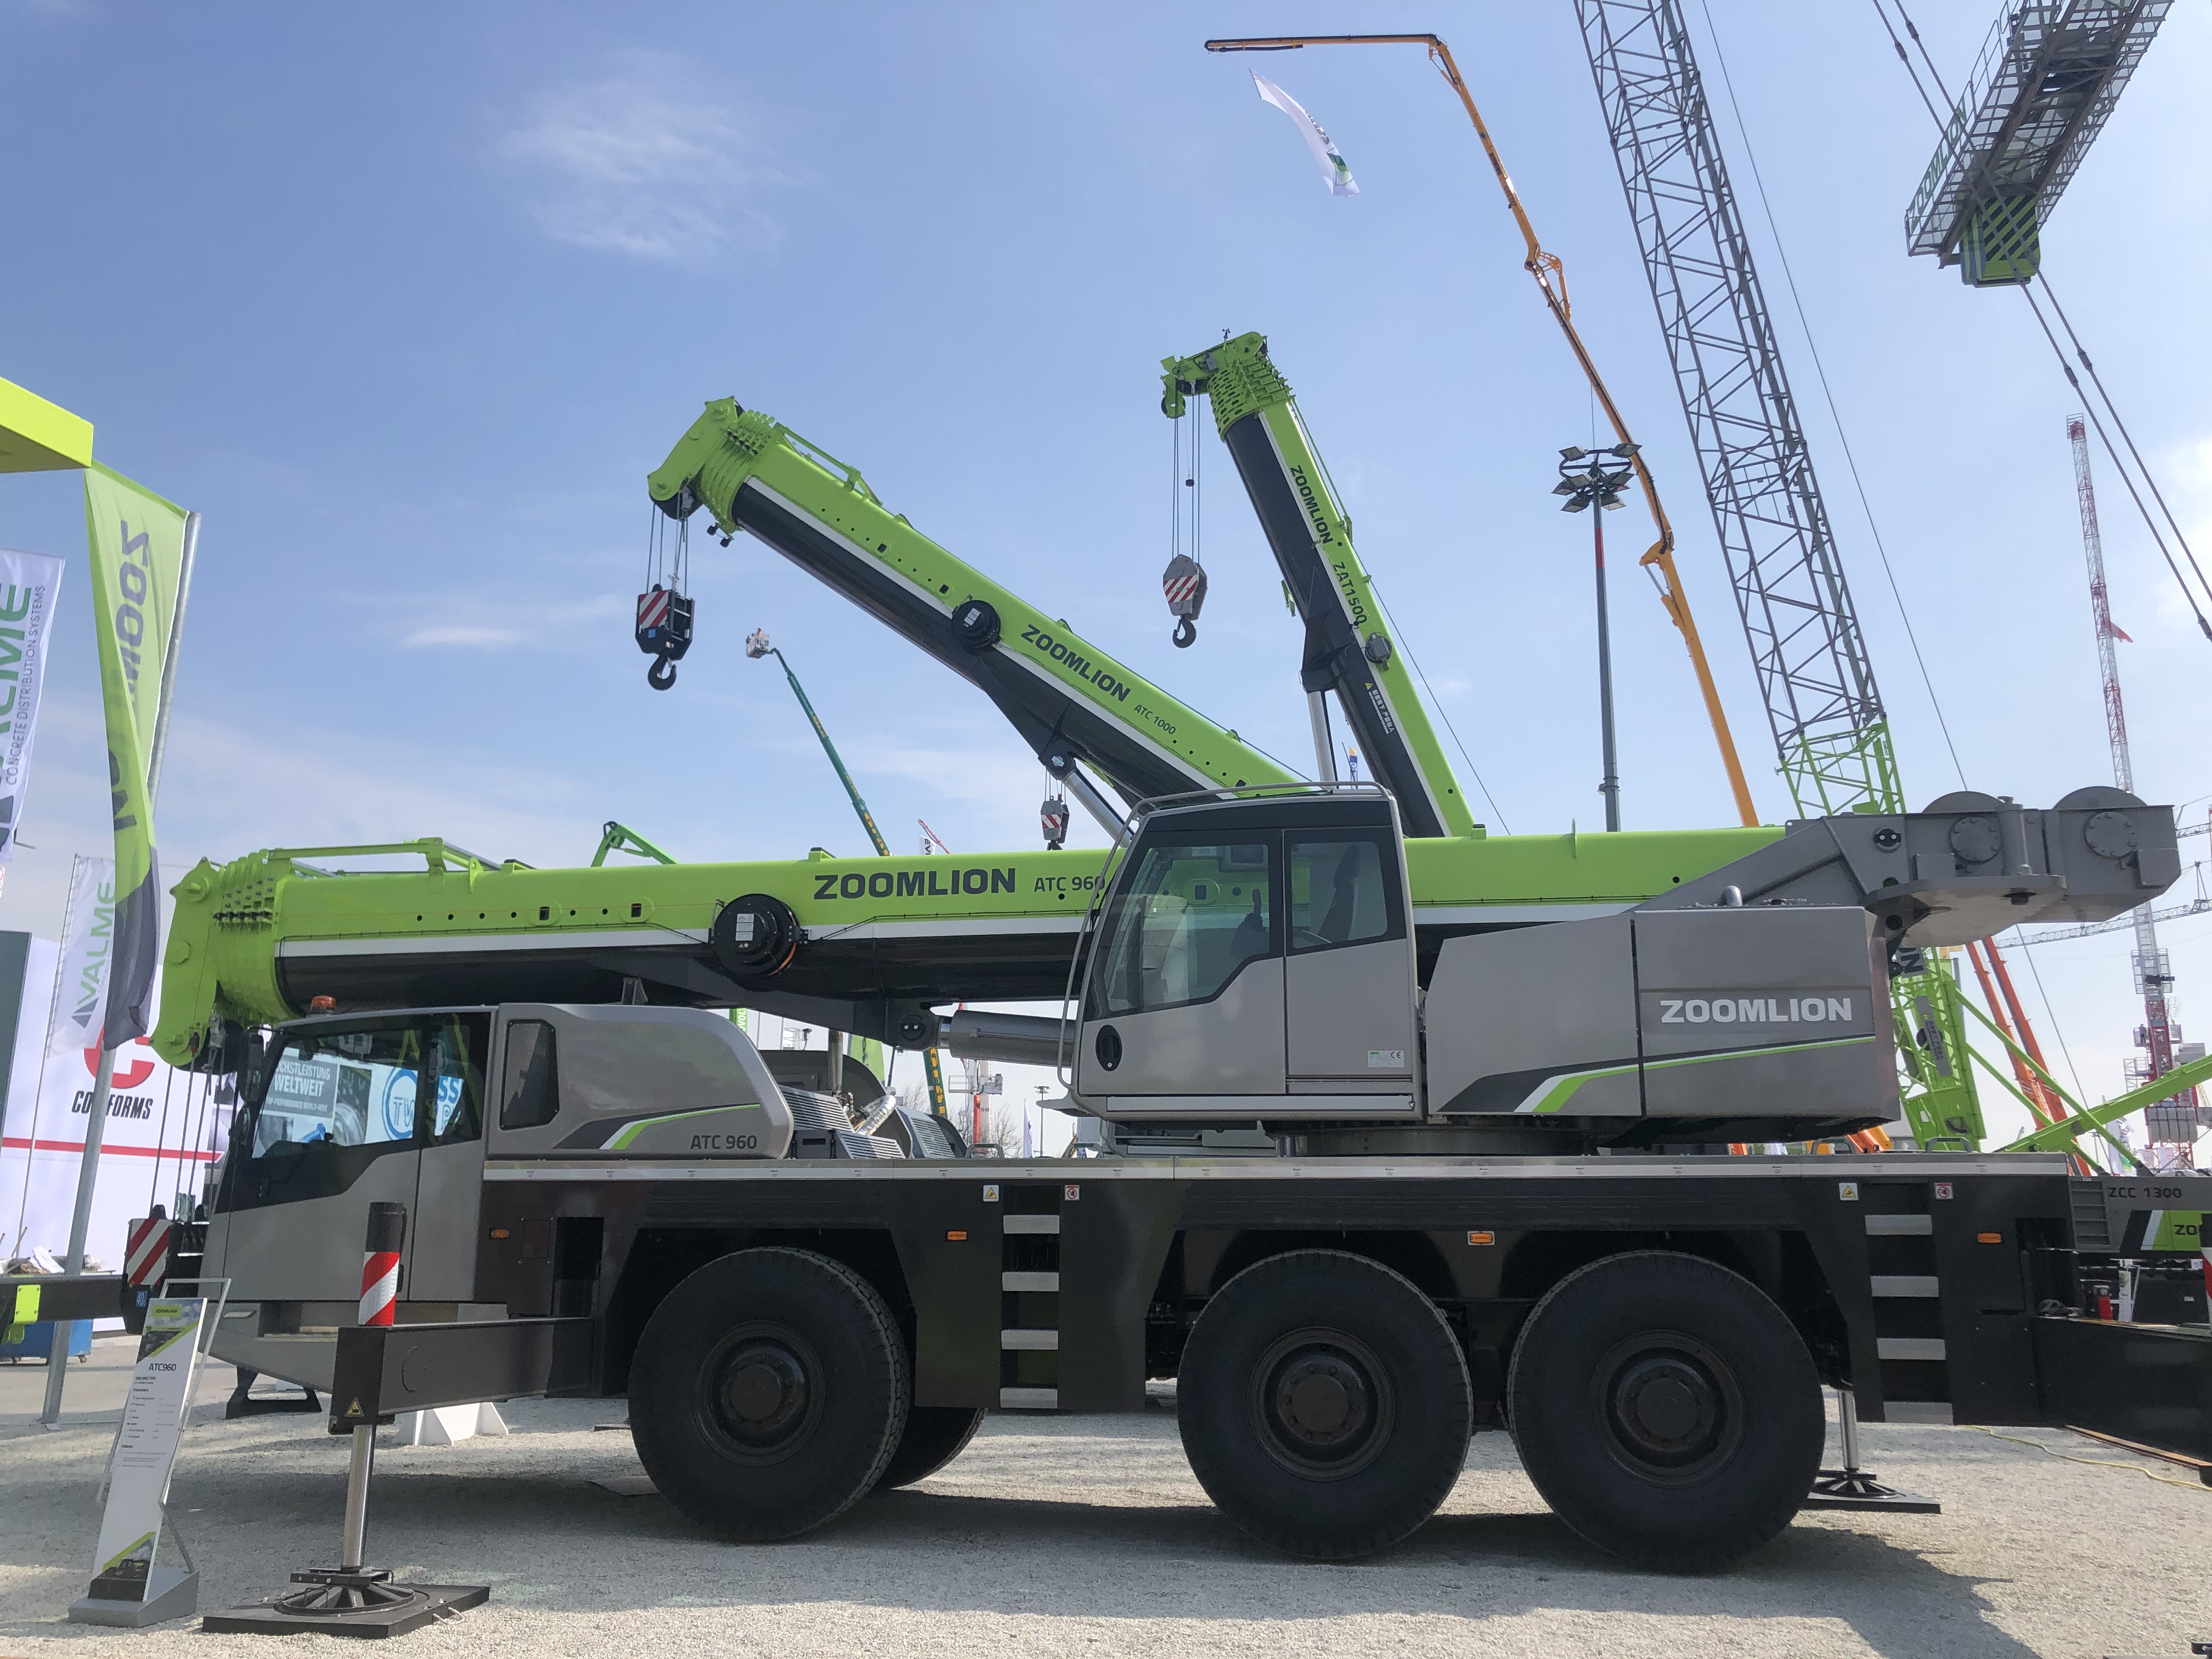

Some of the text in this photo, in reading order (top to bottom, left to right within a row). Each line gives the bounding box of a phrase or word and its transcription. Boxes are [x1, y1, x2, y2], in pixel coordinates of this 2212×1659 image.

[1290, 465, 1333, 545] ZOOMLION
[1333, 561, 1367, 625] ZAT1500
[6, 585, 45, 785] CONCRETE DISTRIBUTION SYSTEMS
[1020, 624, 1176, 735] ZOOMLION ATC 1000
[814, 868, 1105, 900] ZOOMLION ATC 960
[77, 881, 115, 1006] VALME
[1660, 997, 1852, 1024] ZOOMLION
[274, 1074, 325, 1097] WELTWEIT
[71, 1090, 154, 1120] COFORMS
[690, 1135, 757, 1149] ATC 960
[2108, 1187, 2182, 1199] ZCC 1300
[2174, 1224, 2202, 1235] ZO
[148, 1363, 177, 1372] ATC960
